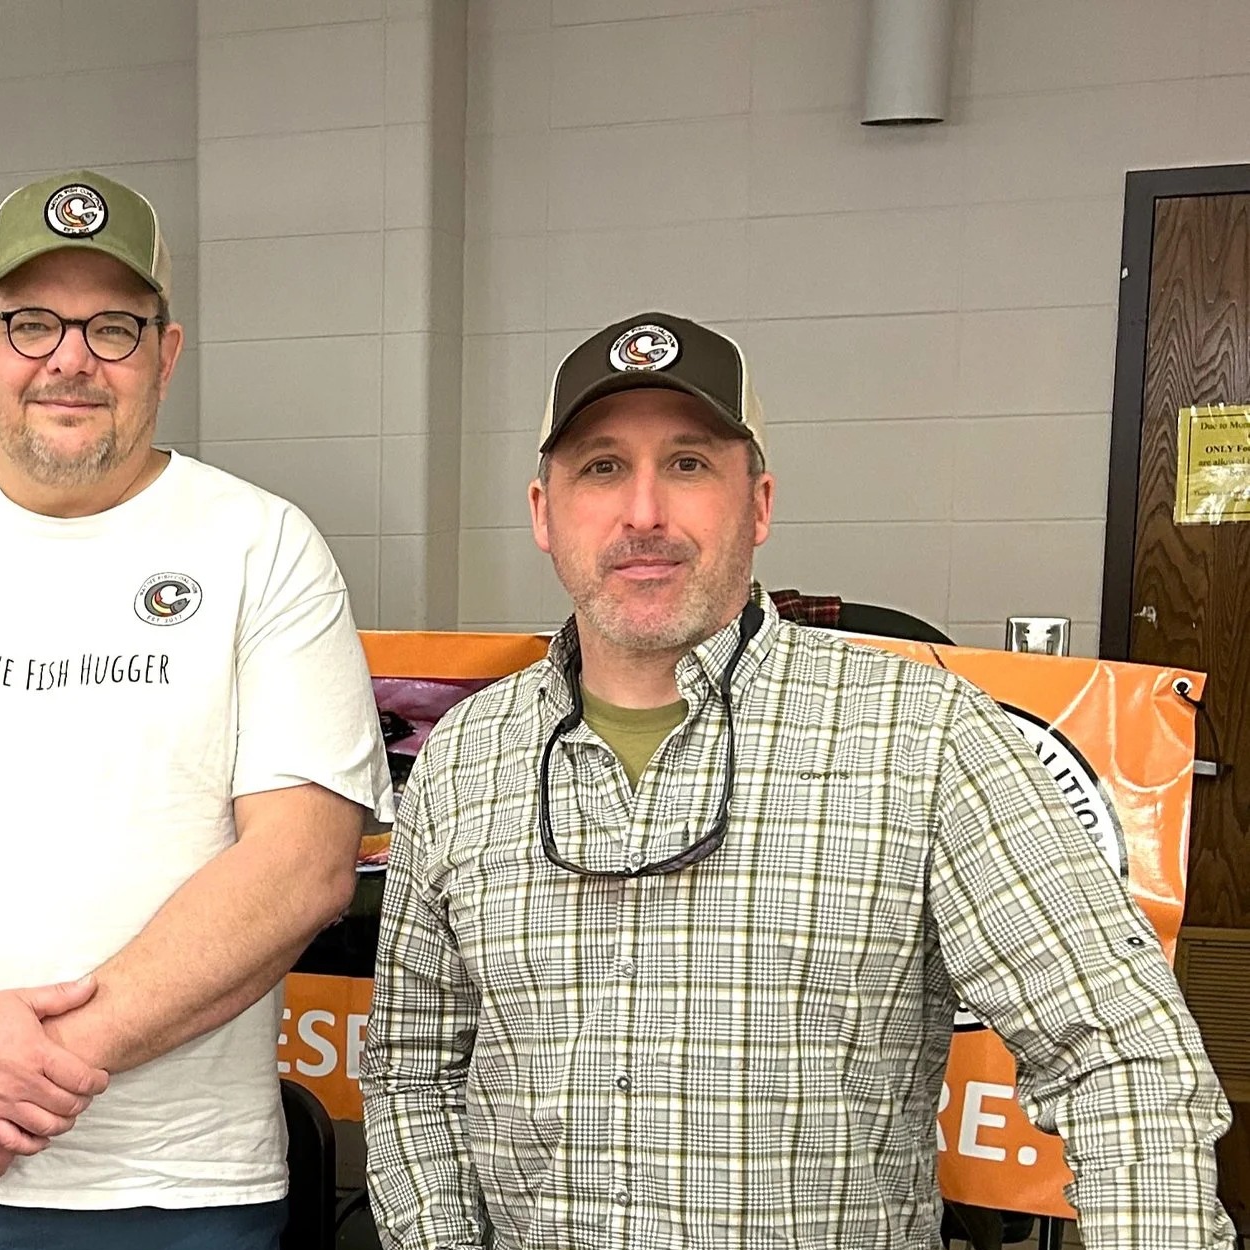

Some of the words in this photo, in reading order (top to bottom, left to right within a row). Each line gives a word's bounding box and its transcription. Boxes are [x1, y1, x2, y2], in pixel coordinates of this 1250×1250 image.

[26, 659, 69, 690] FISH
[80, 653, 170, 685] HUGGER
[800, 771, 850, 781] ORVIS
